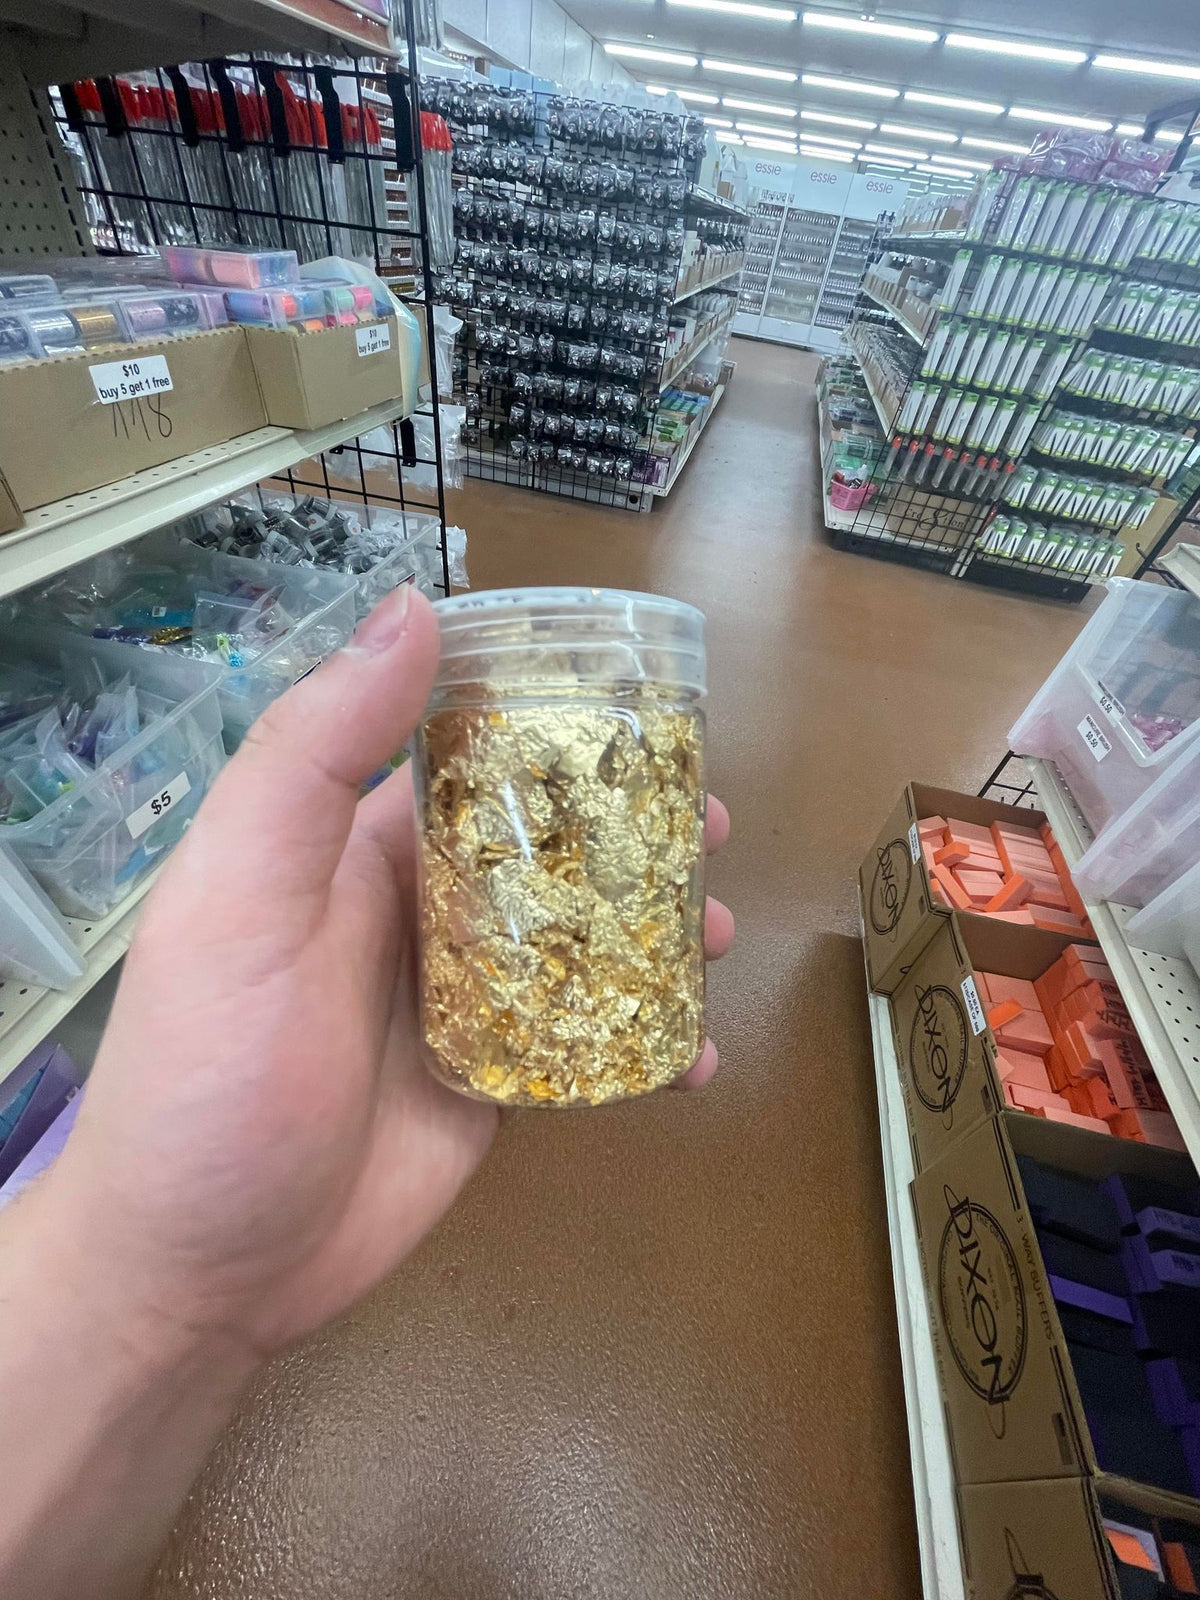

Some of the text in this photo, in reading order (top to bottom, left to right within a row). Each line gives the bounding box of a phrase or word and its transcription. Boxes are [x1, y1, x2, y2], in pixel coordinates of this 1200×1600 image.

[755, 161, 782, 176] essie
[810, 171, 837, 185] essie
[866, 180, 894, 194] essie
[358, 345, 367, 354] buy
[122, 363, 140, 378] $10
[99, 377, 170, 399] buy 5 get 1 free
[1086, 731, 1098, 748] $0.50
[151, 790, 171, 815] $5
[879, 843, 901, 929] DIXON
[916, 985, 956, 1112] DIXON
[949, 1197, 1011, 1405] DIXON
[1030, 1271, 1055, 1341] BUFFERS
